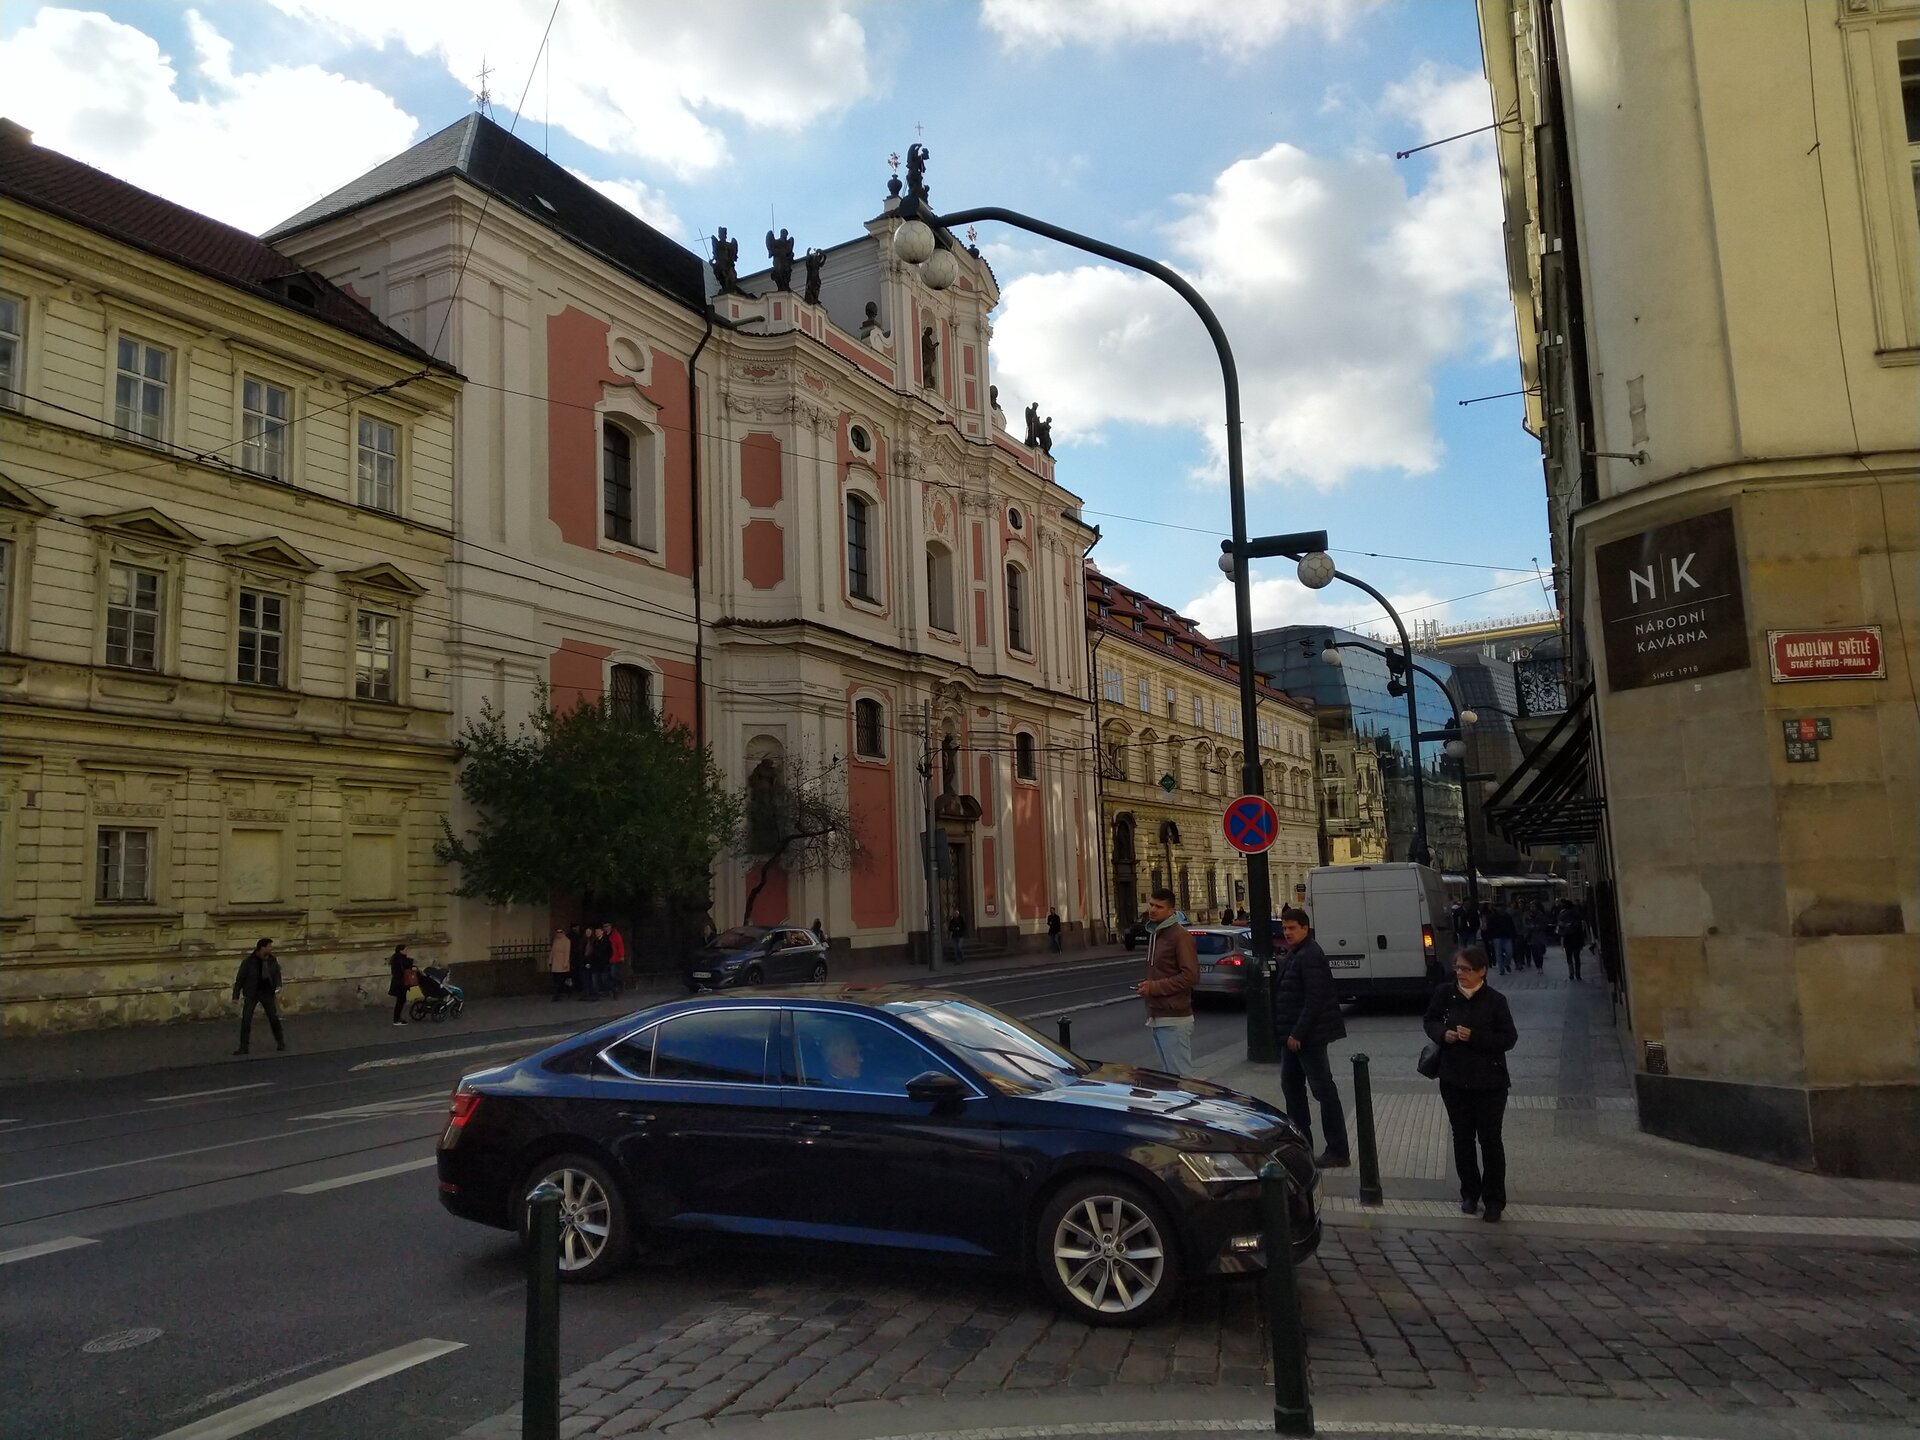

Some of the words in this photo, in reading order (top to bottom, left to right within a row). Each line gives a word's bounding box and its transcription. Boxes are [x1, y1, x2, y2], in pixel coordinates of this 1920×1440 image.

[1635, 608, 1705, 635] NÁRODNÍ
[1637, 629, 1708, 653] KAVÁRNA
[1786, 639, 1833, 657] KAROLÍNY
[1839, 637, 1871, 655] SVĚTLÉ
[1652, 670, 1675, 680] SINCE
[1678, 665, 1699, 676] 1918
[1791, 658, 1813, 669] STARÉ
[1868, 658, 1871, 666] 1
